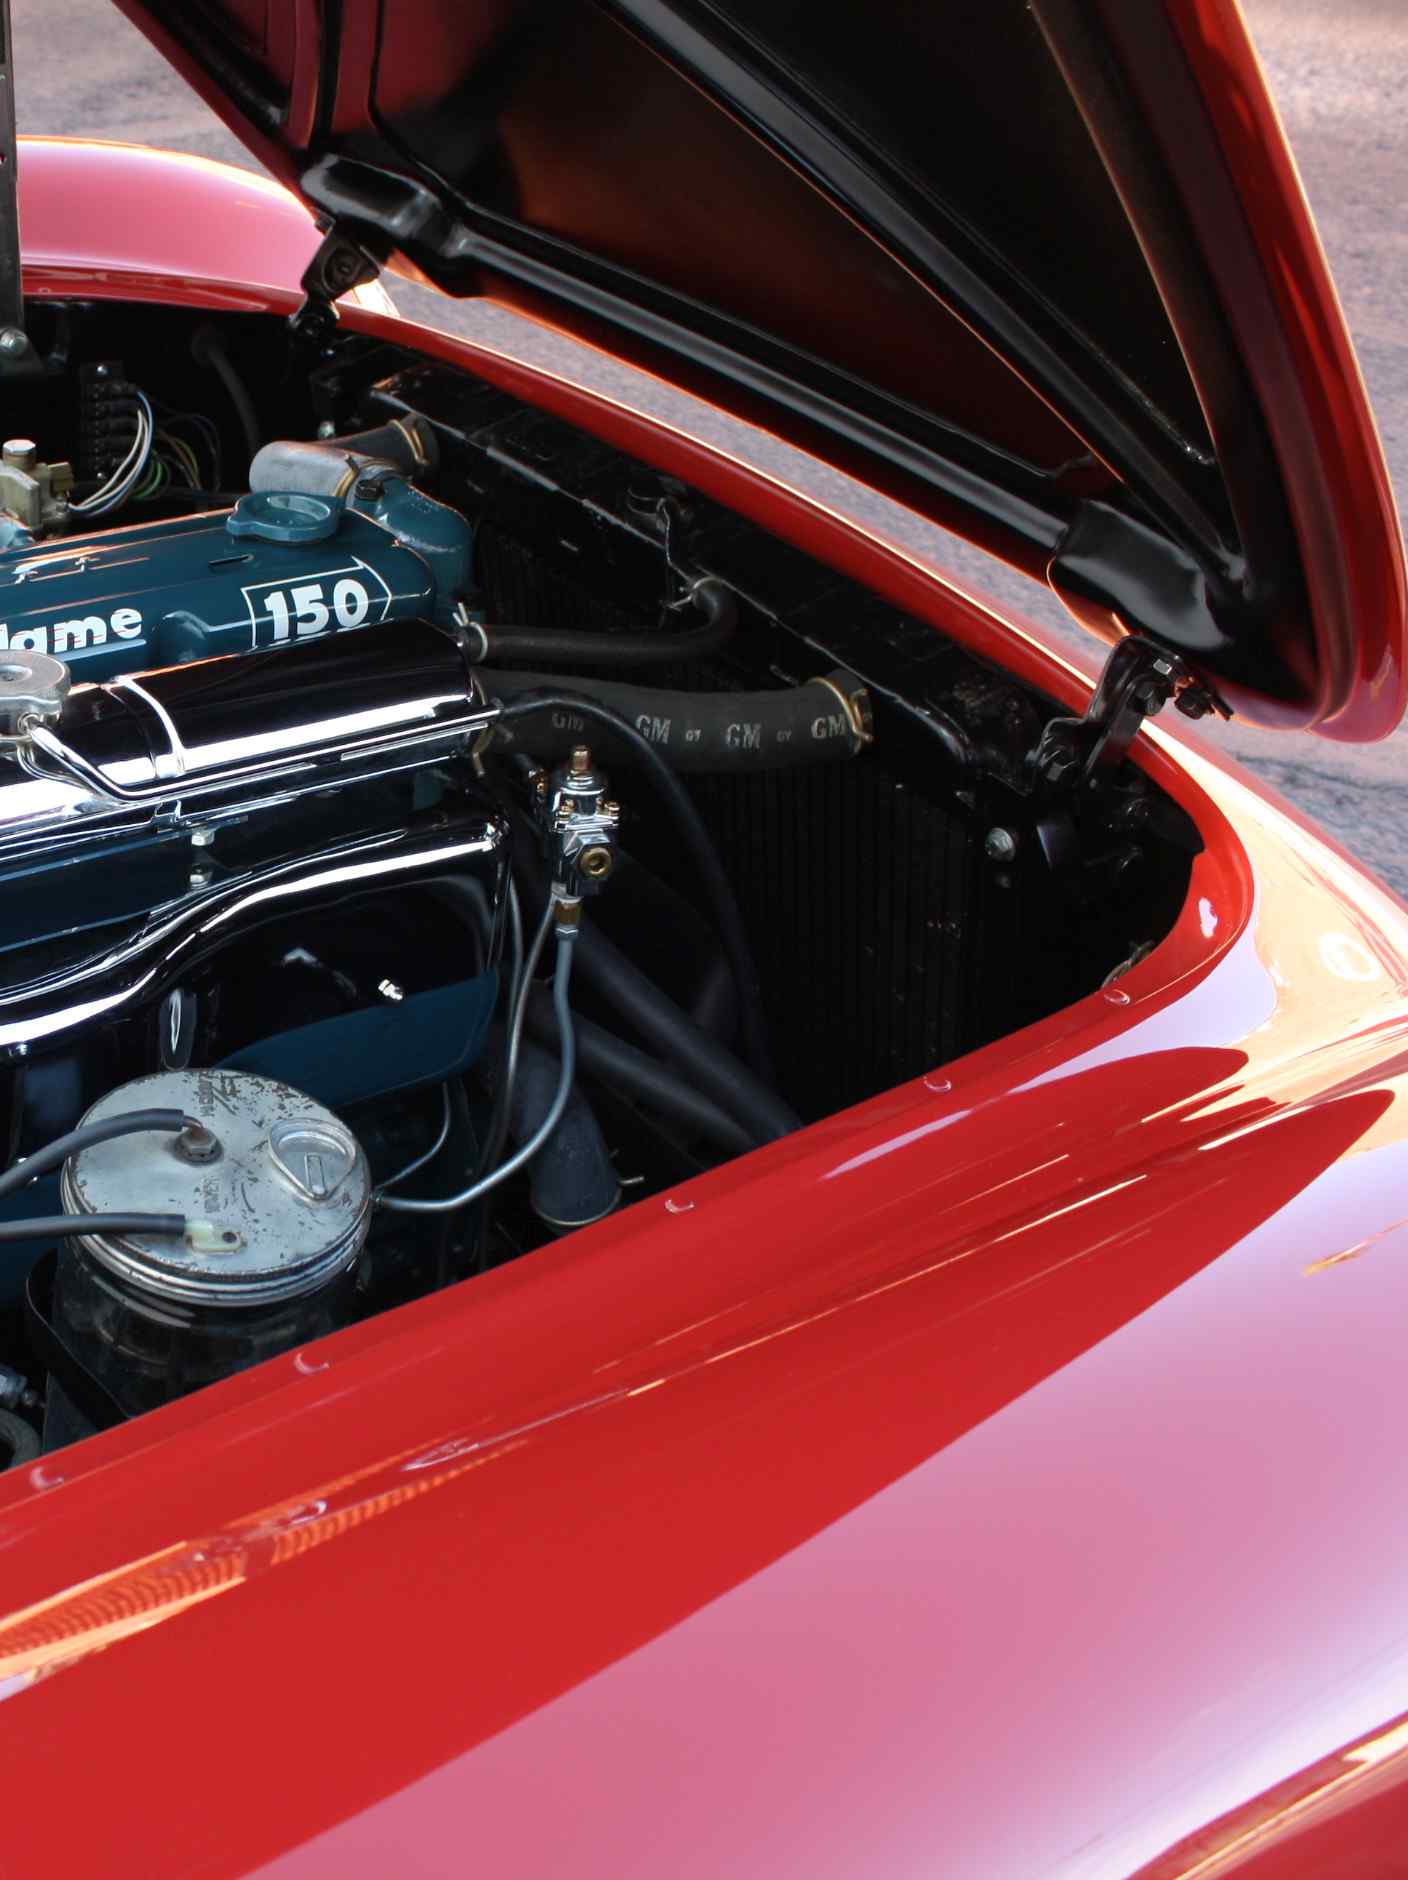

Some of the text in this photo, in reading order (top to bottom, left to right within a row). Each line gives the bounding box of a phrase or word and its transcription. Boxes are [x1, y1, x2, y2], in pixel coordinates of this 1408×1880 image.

[264, 579, 368, 640] 150
[636, 714, 672, 745] GM
[725, 722, 762, 749] GM
[810, 713, 848, 740] GM
